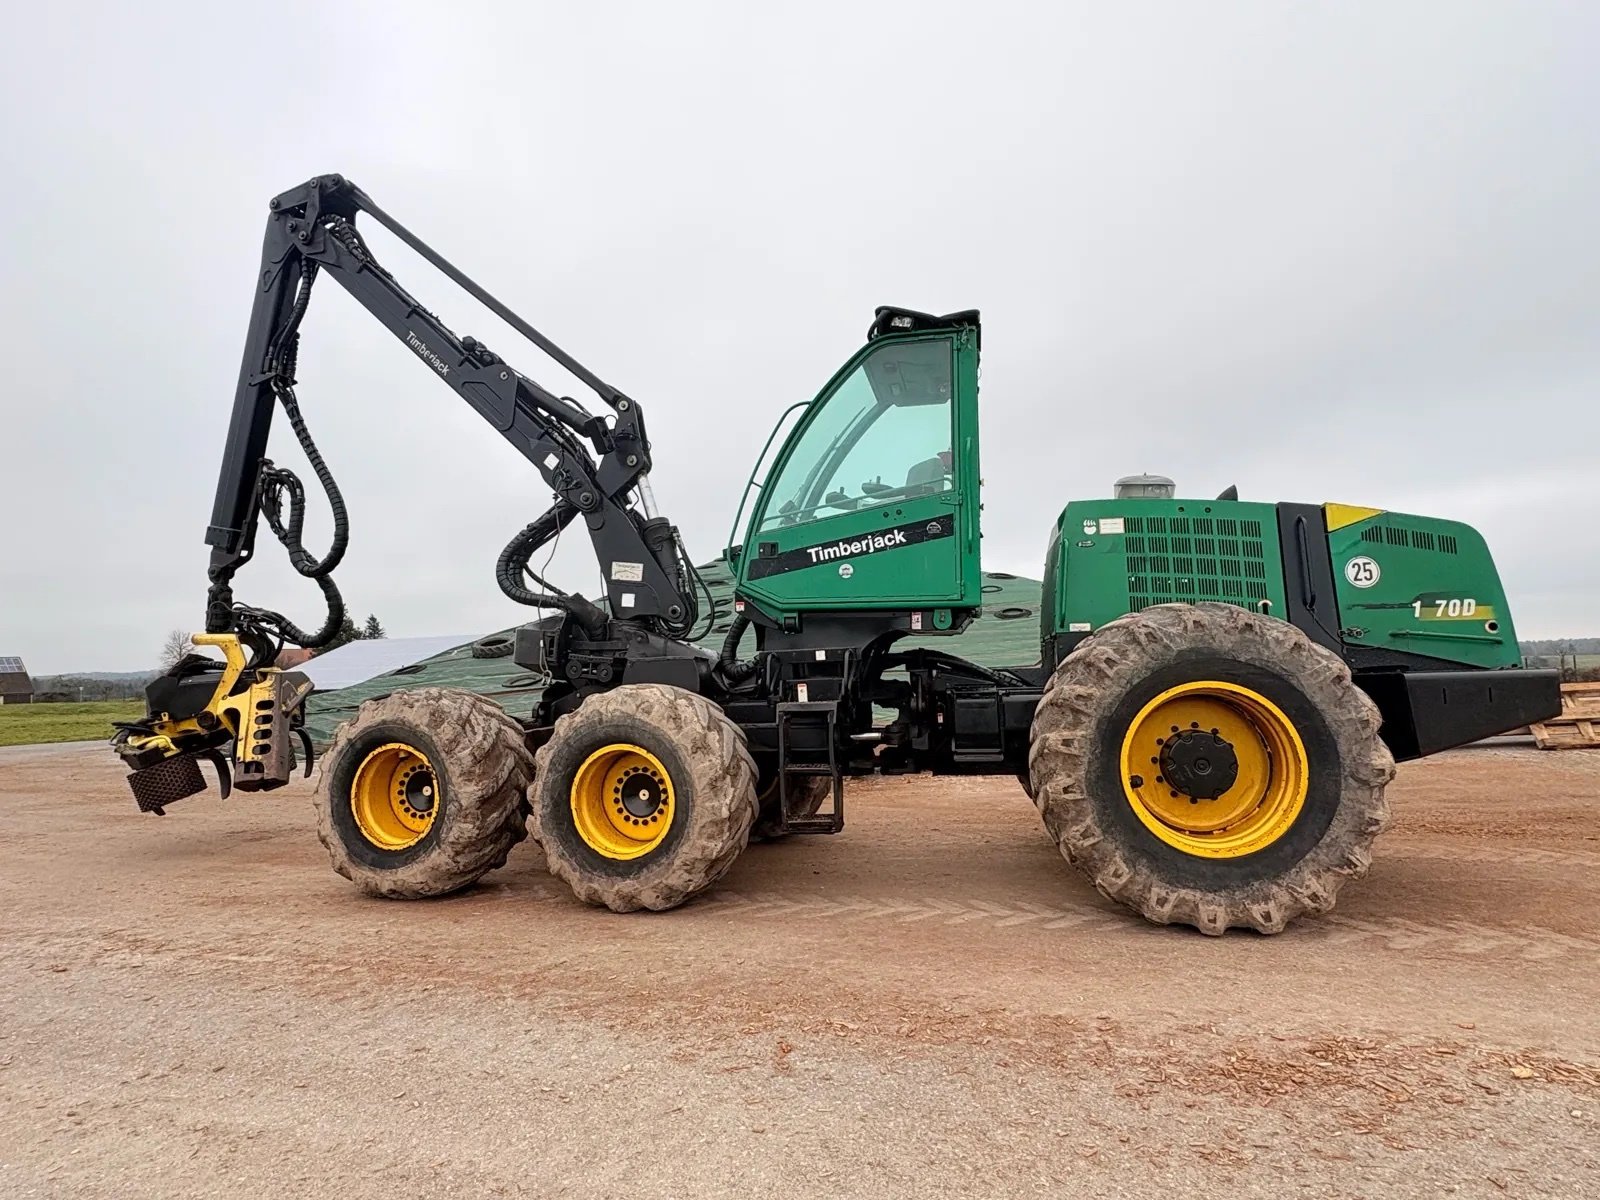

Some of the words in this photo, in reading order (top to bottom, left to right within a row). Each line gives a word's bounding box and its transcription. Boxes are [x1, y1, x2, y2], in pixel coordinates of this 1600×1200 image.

[406, 330, 450, 377] Timberjack
[807, 529, 907, 563] Timberjack
[1351, 562, 1373, 582] 25
